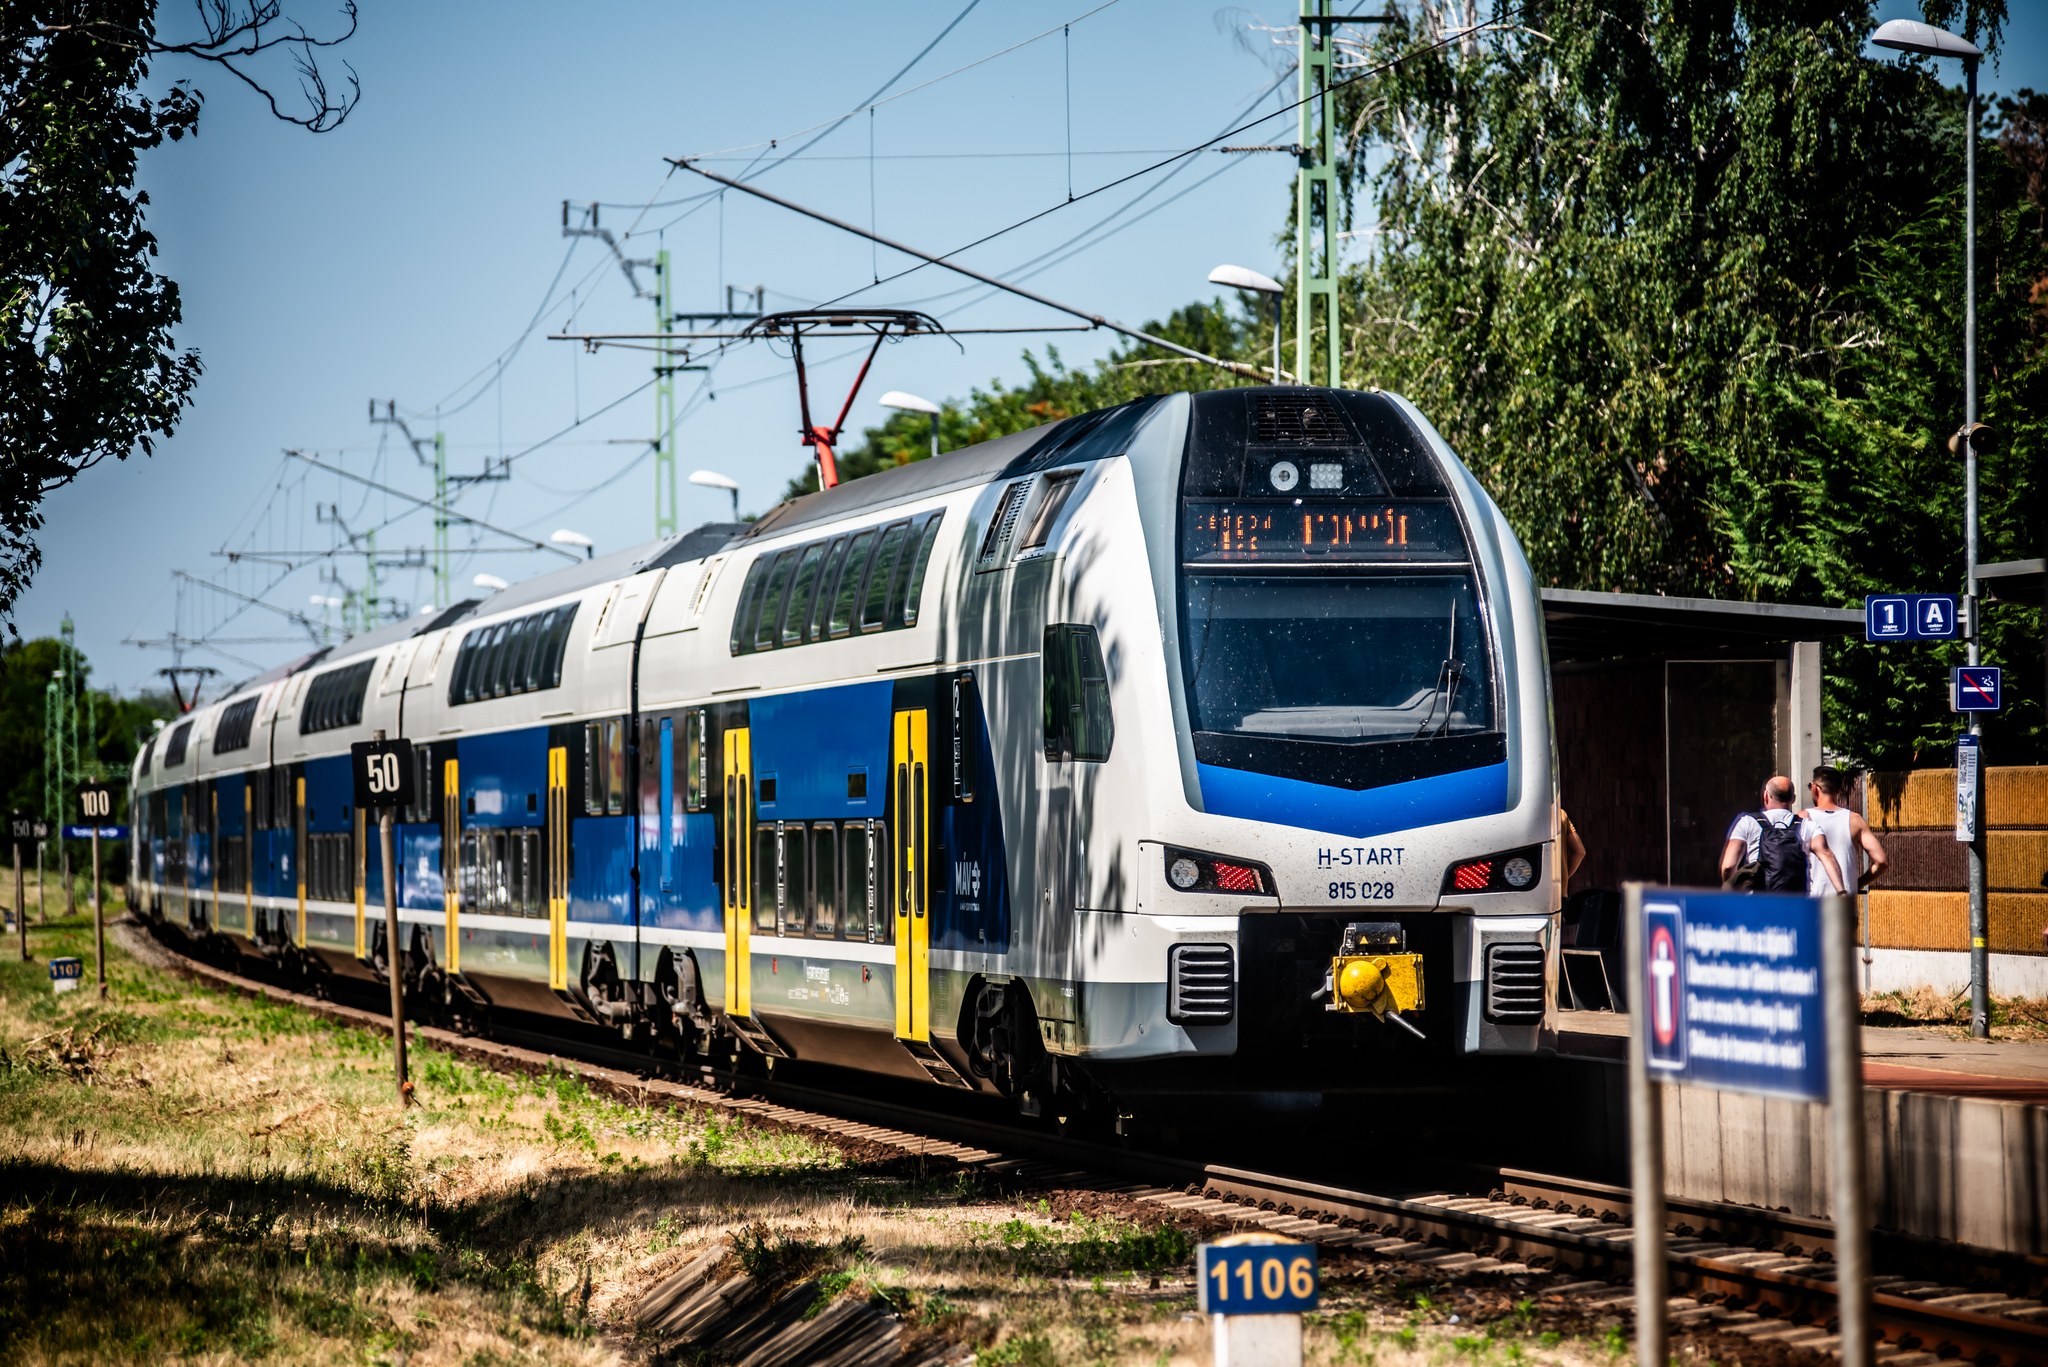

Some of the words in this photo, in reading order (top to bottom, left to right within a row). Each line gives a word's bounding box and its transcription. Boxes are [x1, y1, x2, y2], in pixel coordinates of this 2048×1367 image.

[1884, 604, 1894, 624] 1
[1926, 603, 1944, 623] A
[366, 752, 400, 793] 50
[80, 790, 110, 816] 100
[1318, 848, 1405, 866] H-START
[1328, 882, 1357, 899] 815
[1361, 882, 1394, 899] 028
[51, 963, 81, 977] 1107
[1210, 1256, 1314, 1301] 1106
